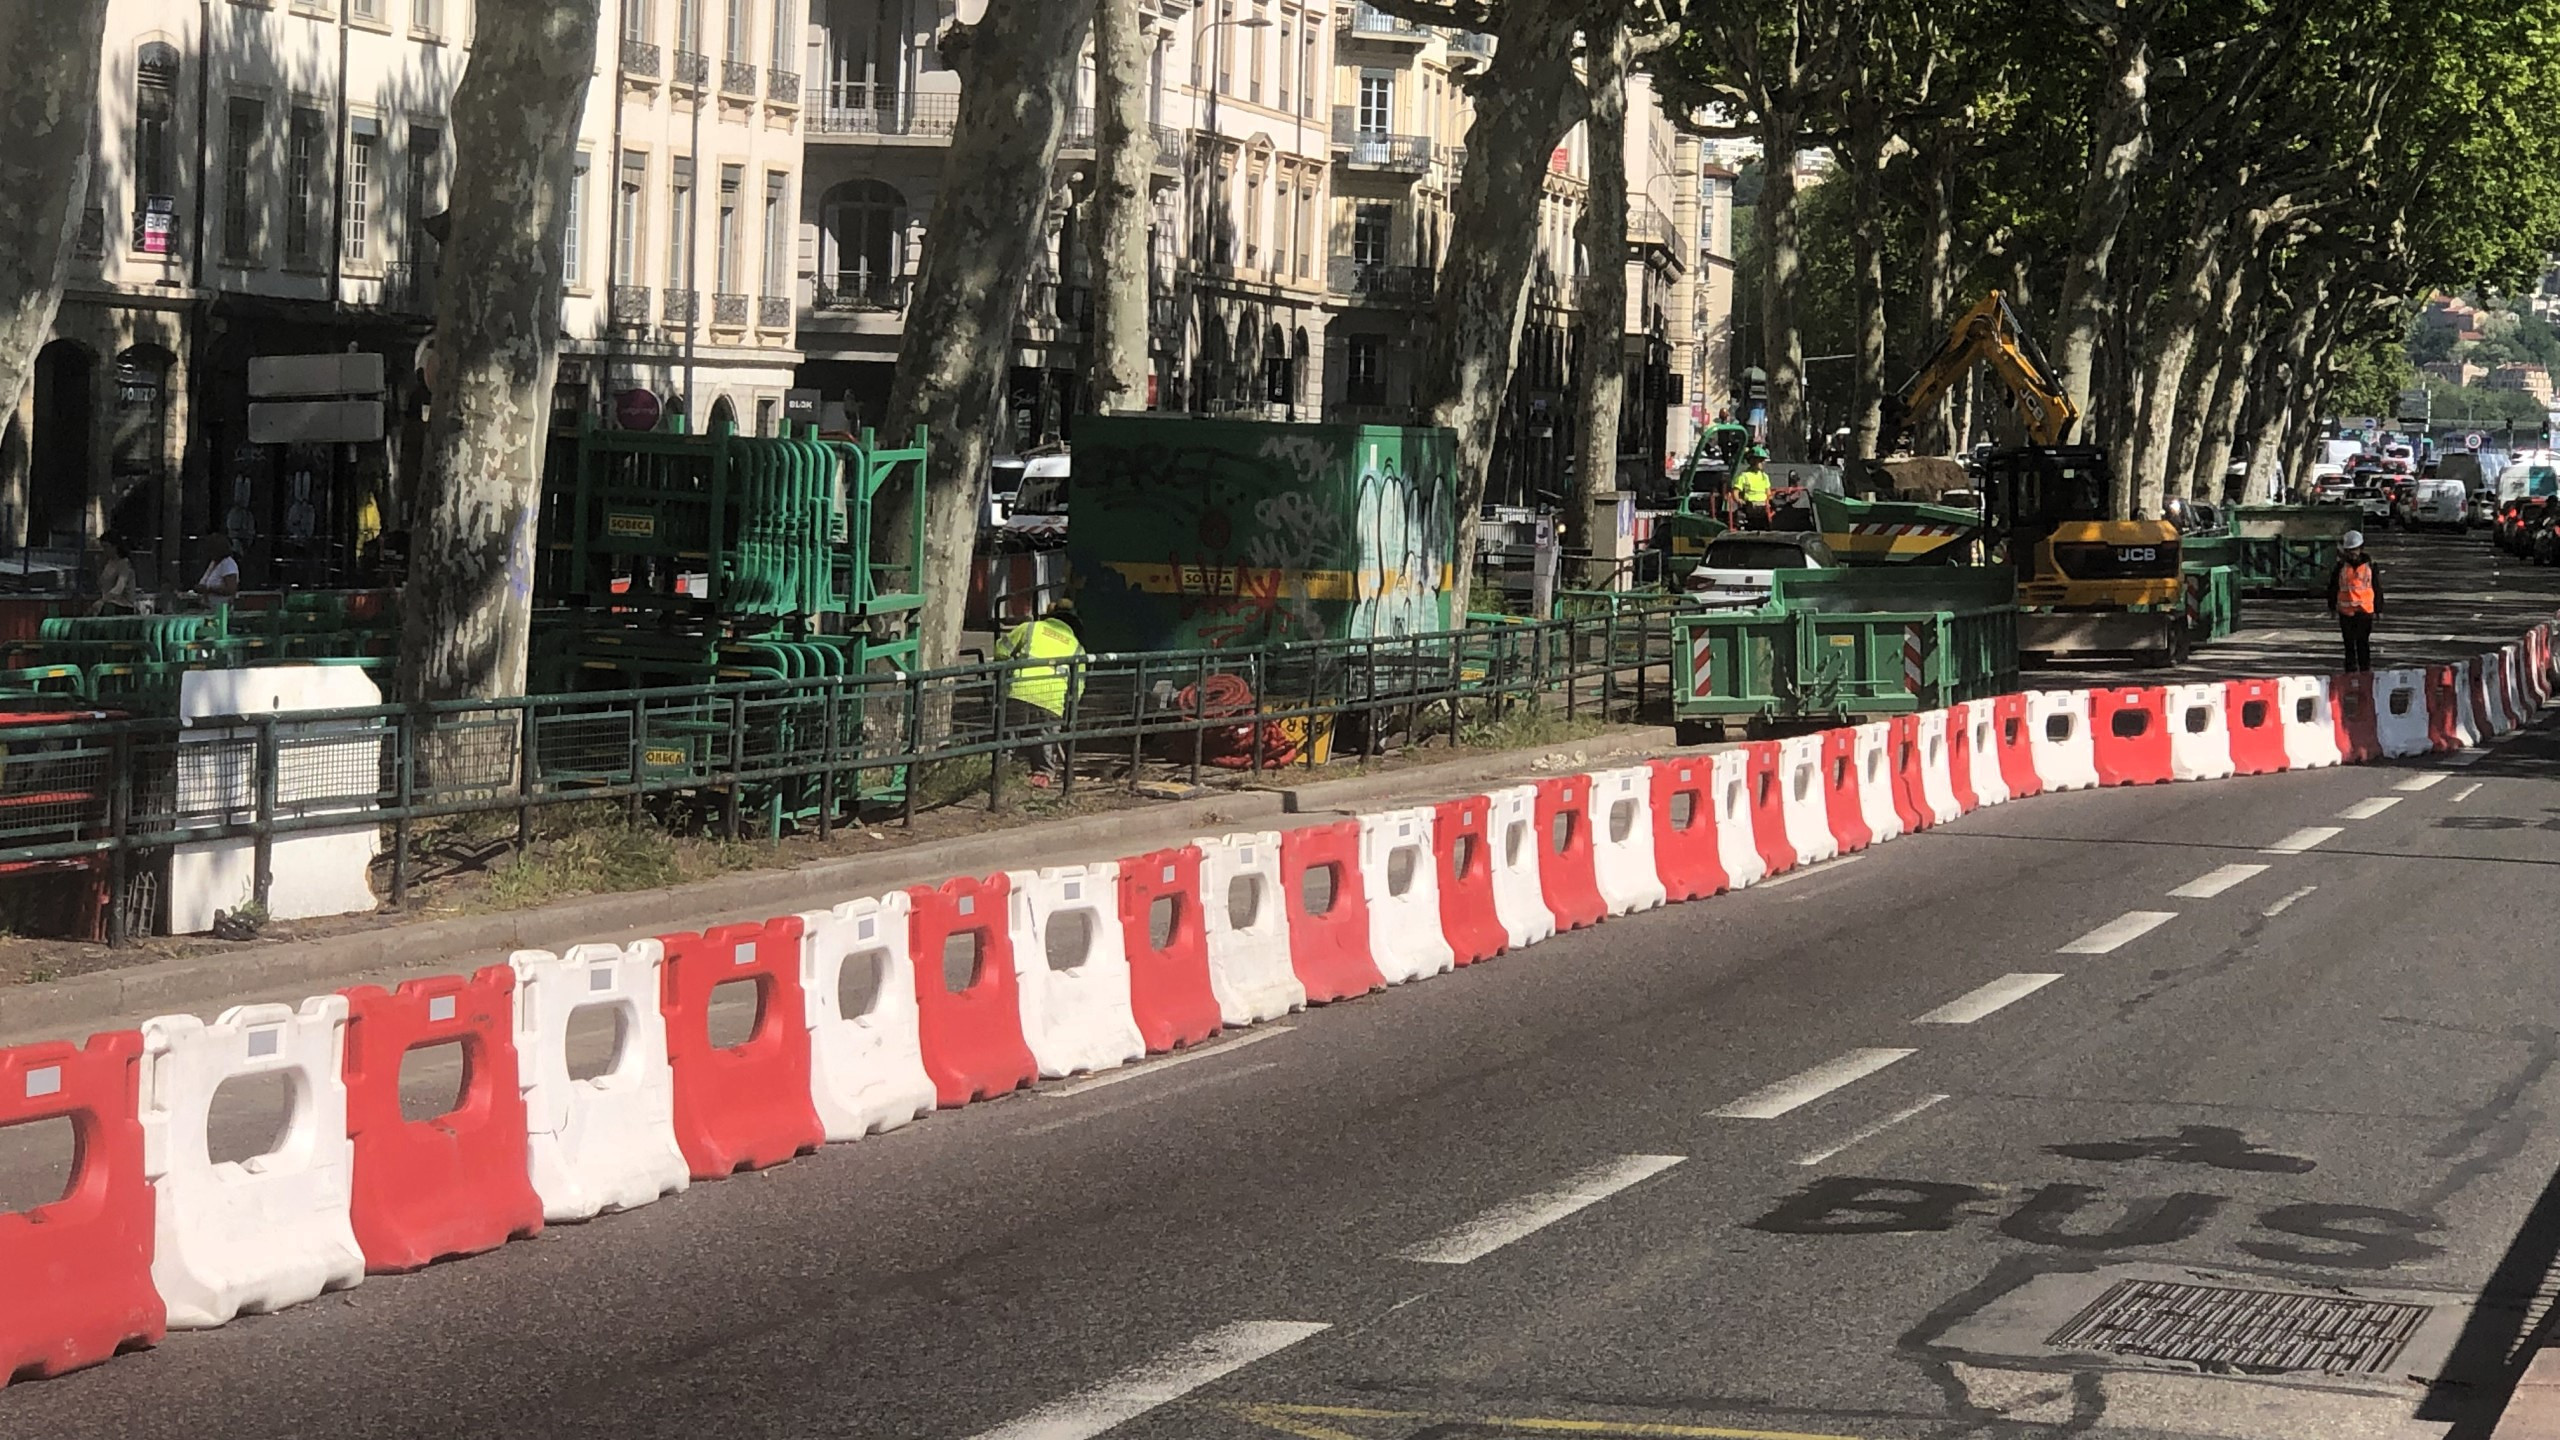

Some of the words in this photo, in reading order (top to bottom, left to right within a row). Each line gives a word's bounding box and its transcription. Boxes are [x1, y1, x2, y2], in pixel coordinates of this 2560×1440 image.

[2019, 388, 2044, 421] JCB
[611, 518, 652, 531] SOBECA
[2117, 547, 2157, 563] JCB
[646, 752, 683, 765] OBECA
[1742, 1175, 2447, 1270] BUS
